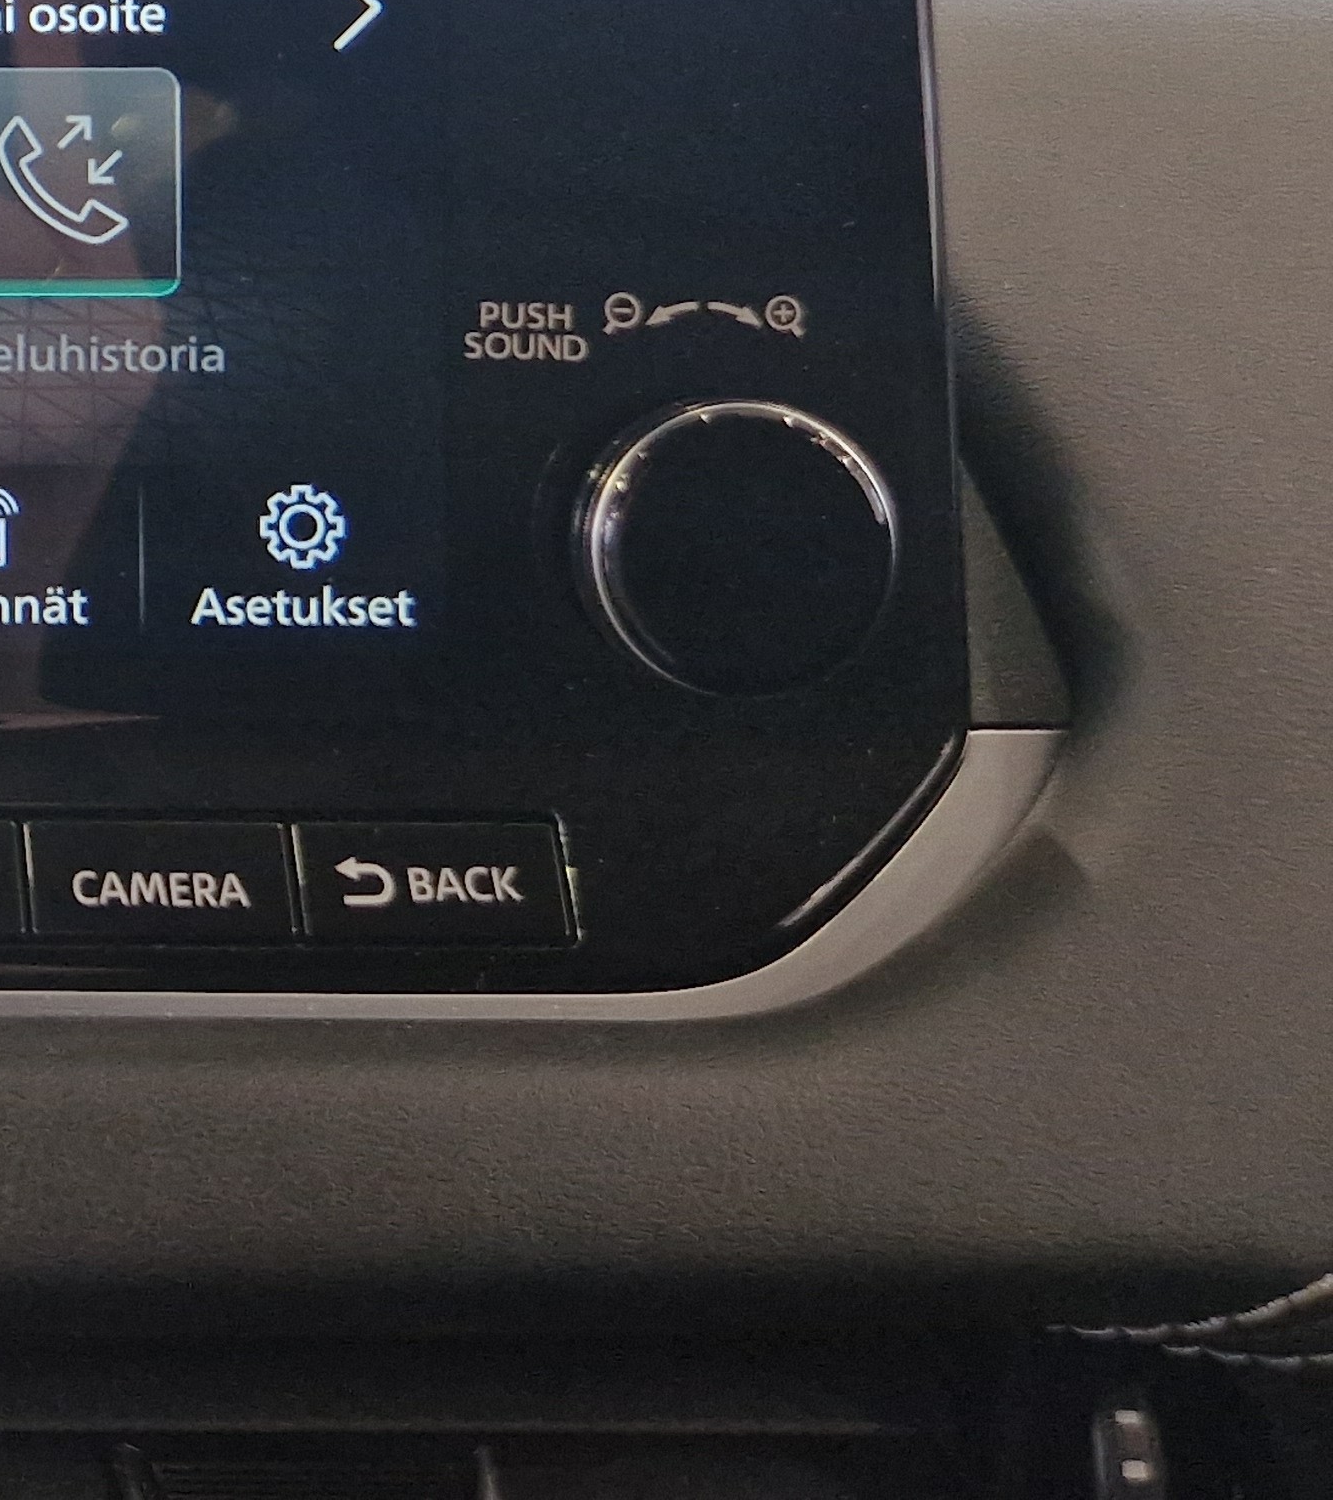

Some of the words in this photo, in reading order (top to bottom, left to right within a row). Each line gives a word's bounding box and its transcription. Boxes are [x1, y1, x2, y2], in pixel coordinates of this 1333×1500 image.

[479, 300, 574, 331] PUSH
[463, 331, 589, 363] SOUND
[190, 585, 416, 629] Asetukset
[71, 869, 250, 909] CAMERA
[406, 865, 523, 904] BACK
